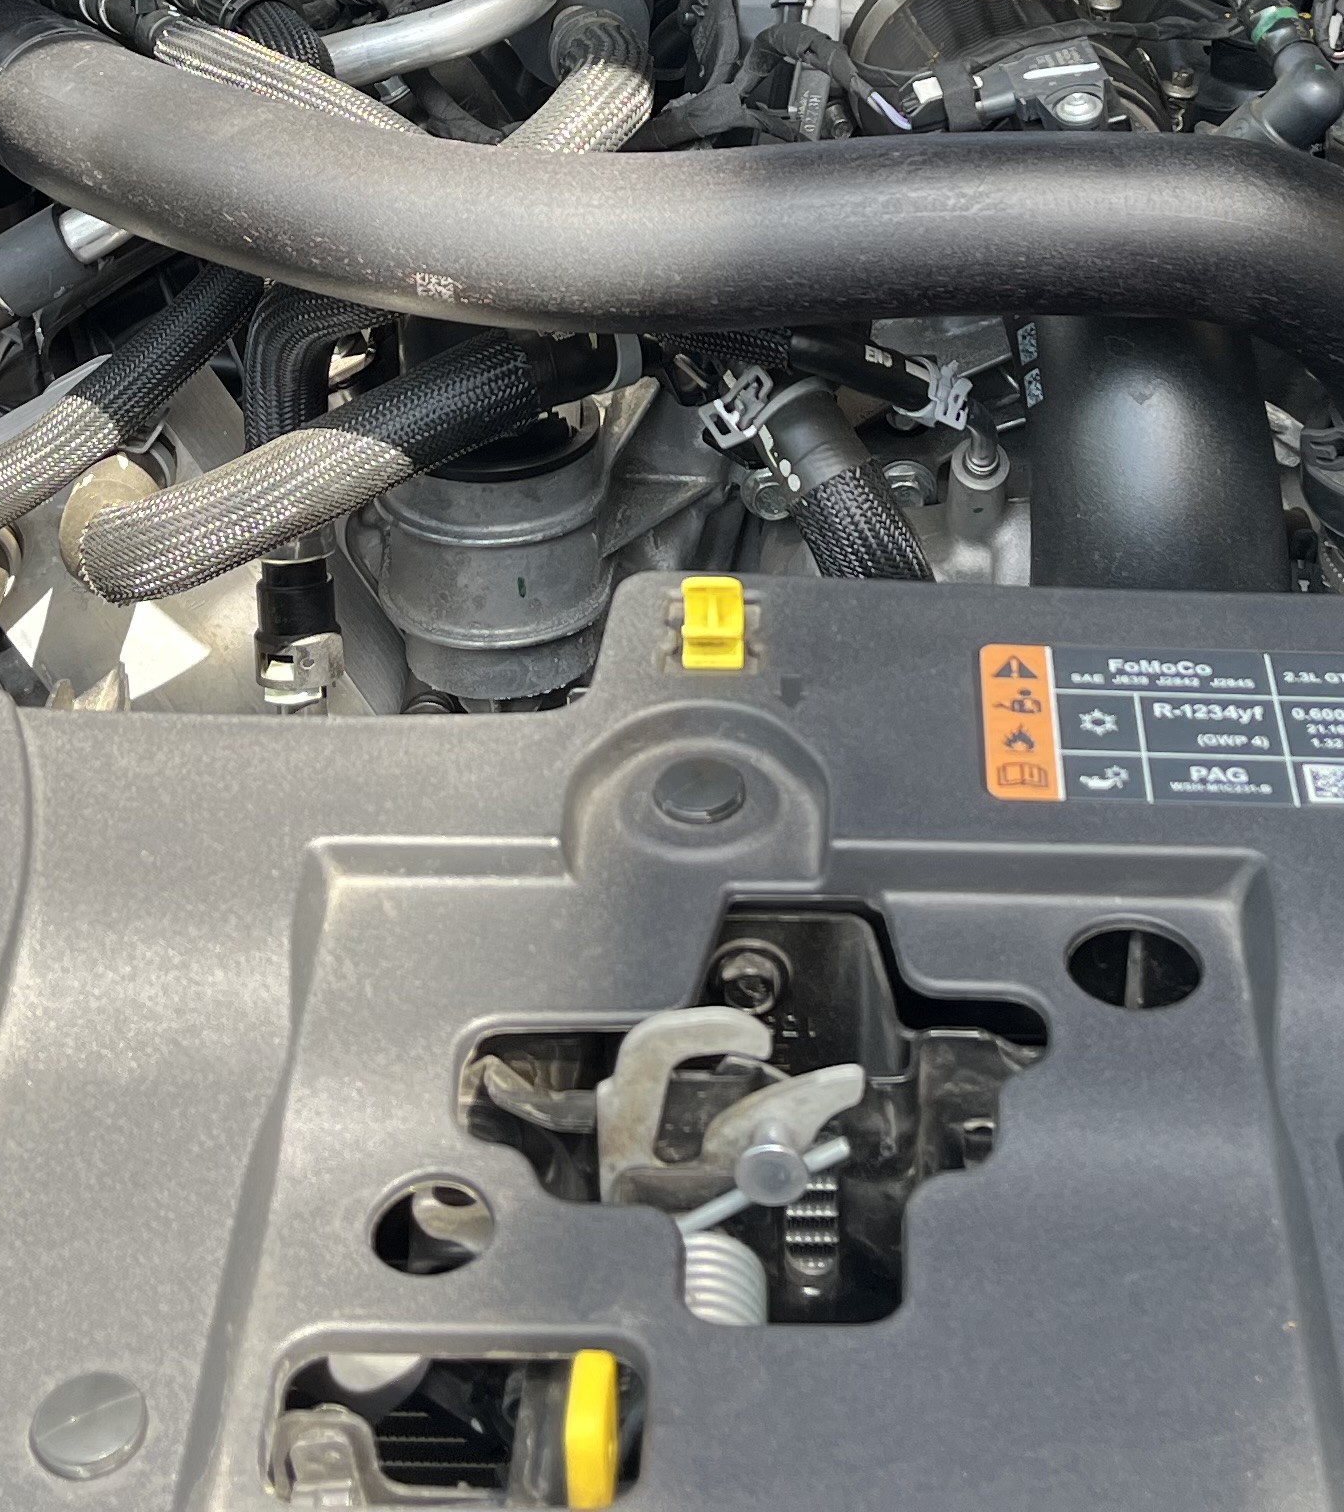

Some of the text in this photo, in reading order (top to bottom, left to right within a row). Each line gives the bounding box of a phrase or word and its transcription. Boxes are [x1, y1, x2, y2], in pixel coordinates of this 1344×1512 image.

[1107, 658, 1214, 677] FoMoCo
[1070, 672, 1106, 685] SAE
[1111, 674, 1150, 686] J639
[1282, 670, 1323, 685] 2.3L
[1152, 702, 1265, 725] R-1234yf
[1196, 733, 1271, 750] (GWP 4)
[1310, 737, 1344, 750] 1.32
[1189, 765, 1251, 784] PAG
